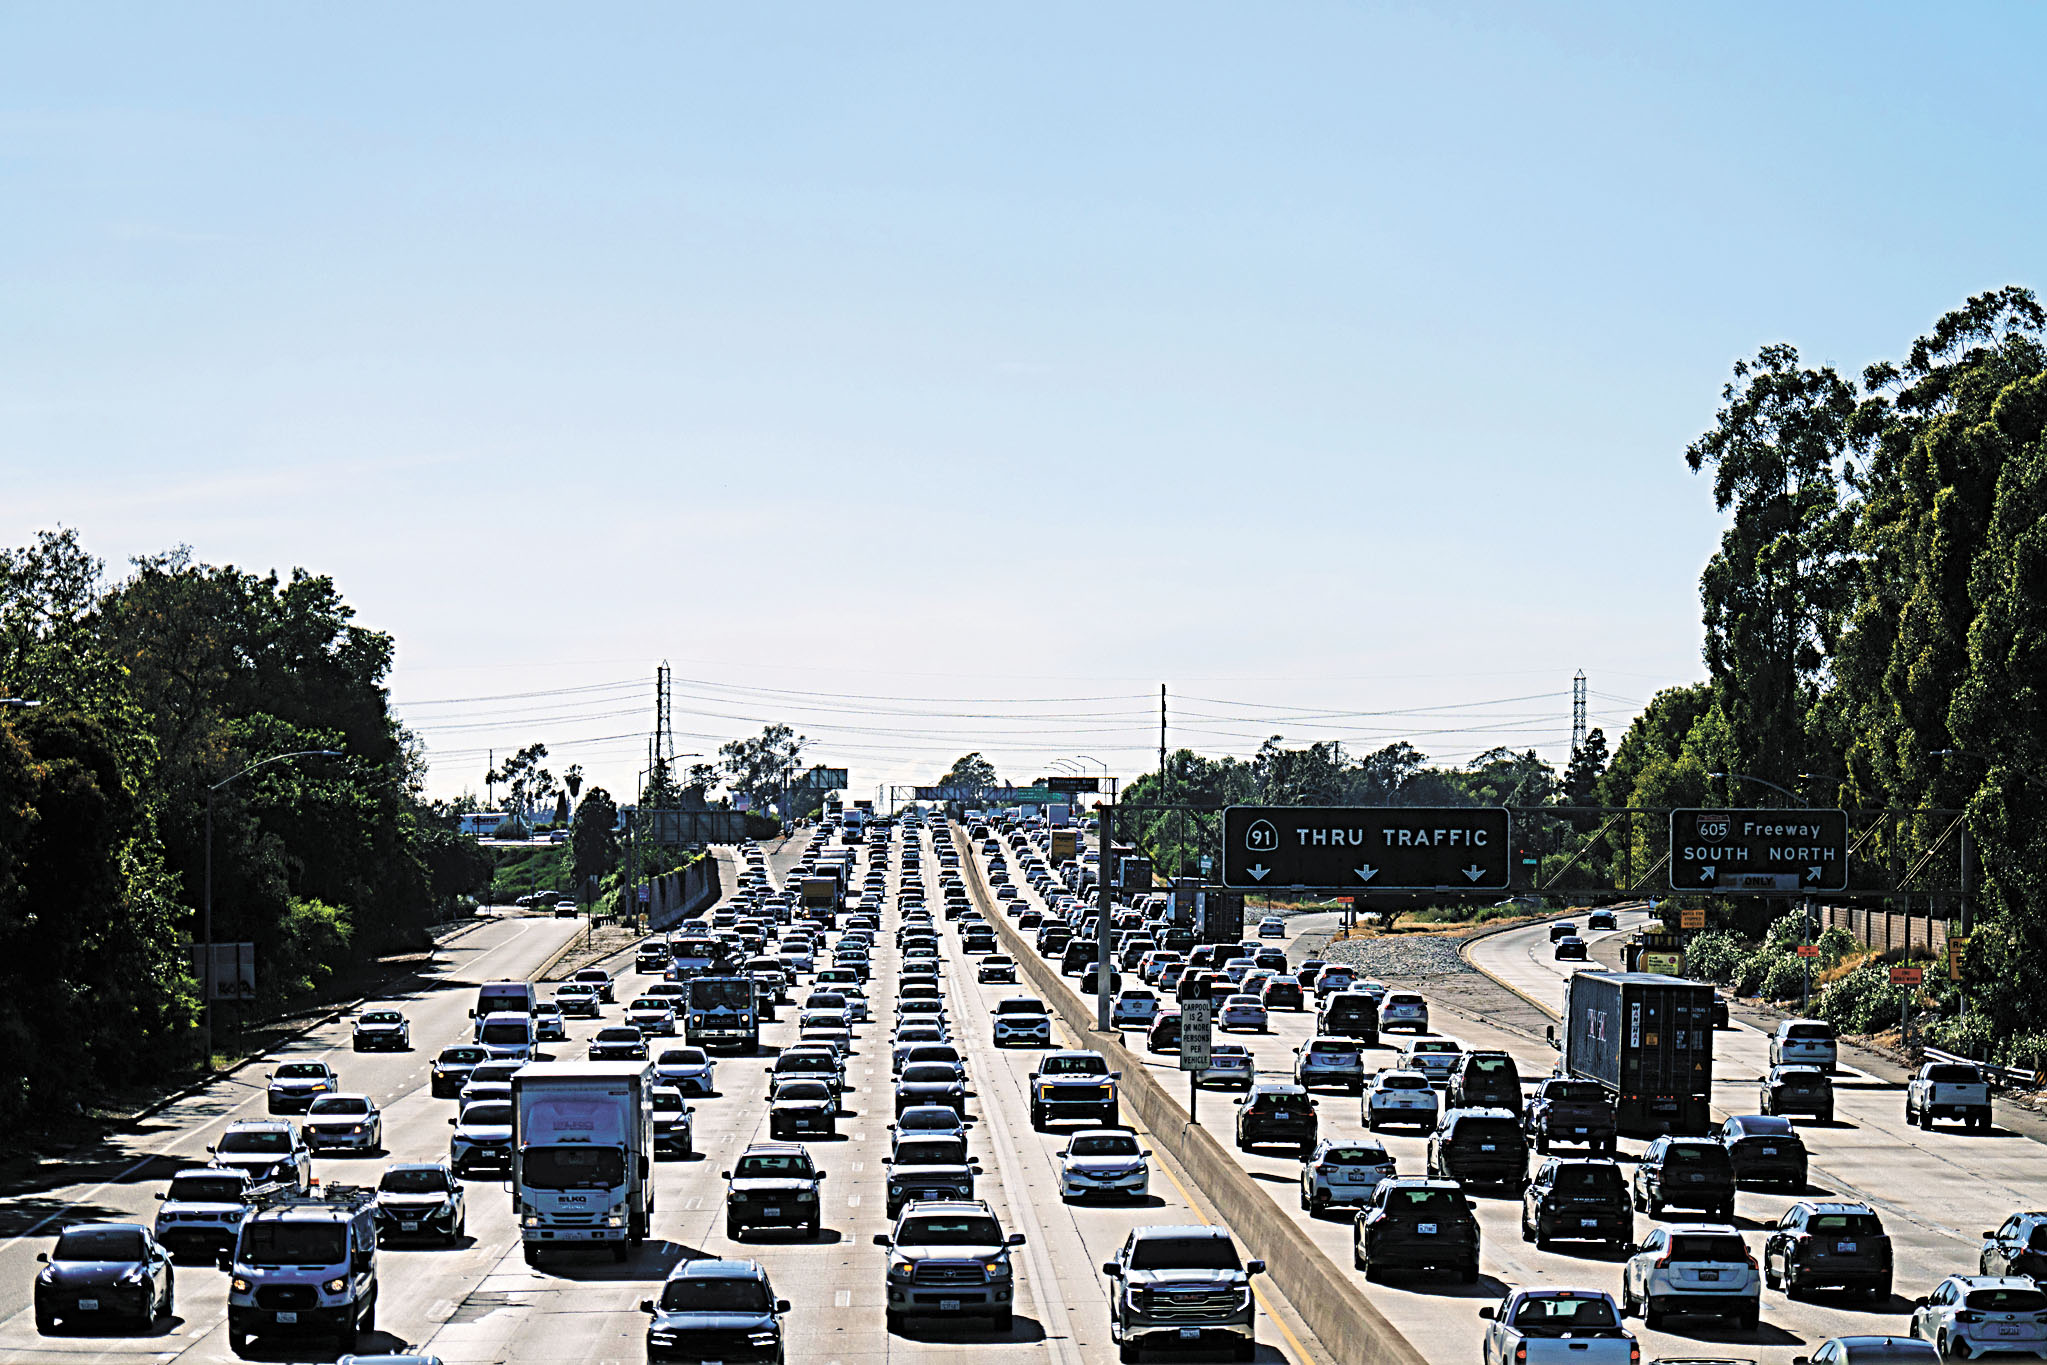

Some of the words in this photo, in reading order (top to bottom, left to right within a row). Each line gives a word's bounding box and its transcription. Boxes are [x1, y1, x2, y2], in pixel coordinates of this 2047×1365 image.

[1700, 823, 1727, 836] 605
[1744, 822, 1820, 839] Freeway
[1251, 830, 1271, 846] 91
[1296, 828, 1364, 846] THRU
[1382, 829, 1488, 846] TRAFFIC
[1684, 847, 1748, 860] SOUTH
[1769, 847, 1835, 860] NORTH
[1744, 876, 1774, 886] ONLY
[1183, 1003, 1210, 1011] CARPOOL
[1189, 1013, 1196, 1021] IS
[1196, 1012, 1203, 1022] 2
[1190, 1045, 1202, 1053] PER
[1183, 1056, 1208, 1064] VEHICLE
